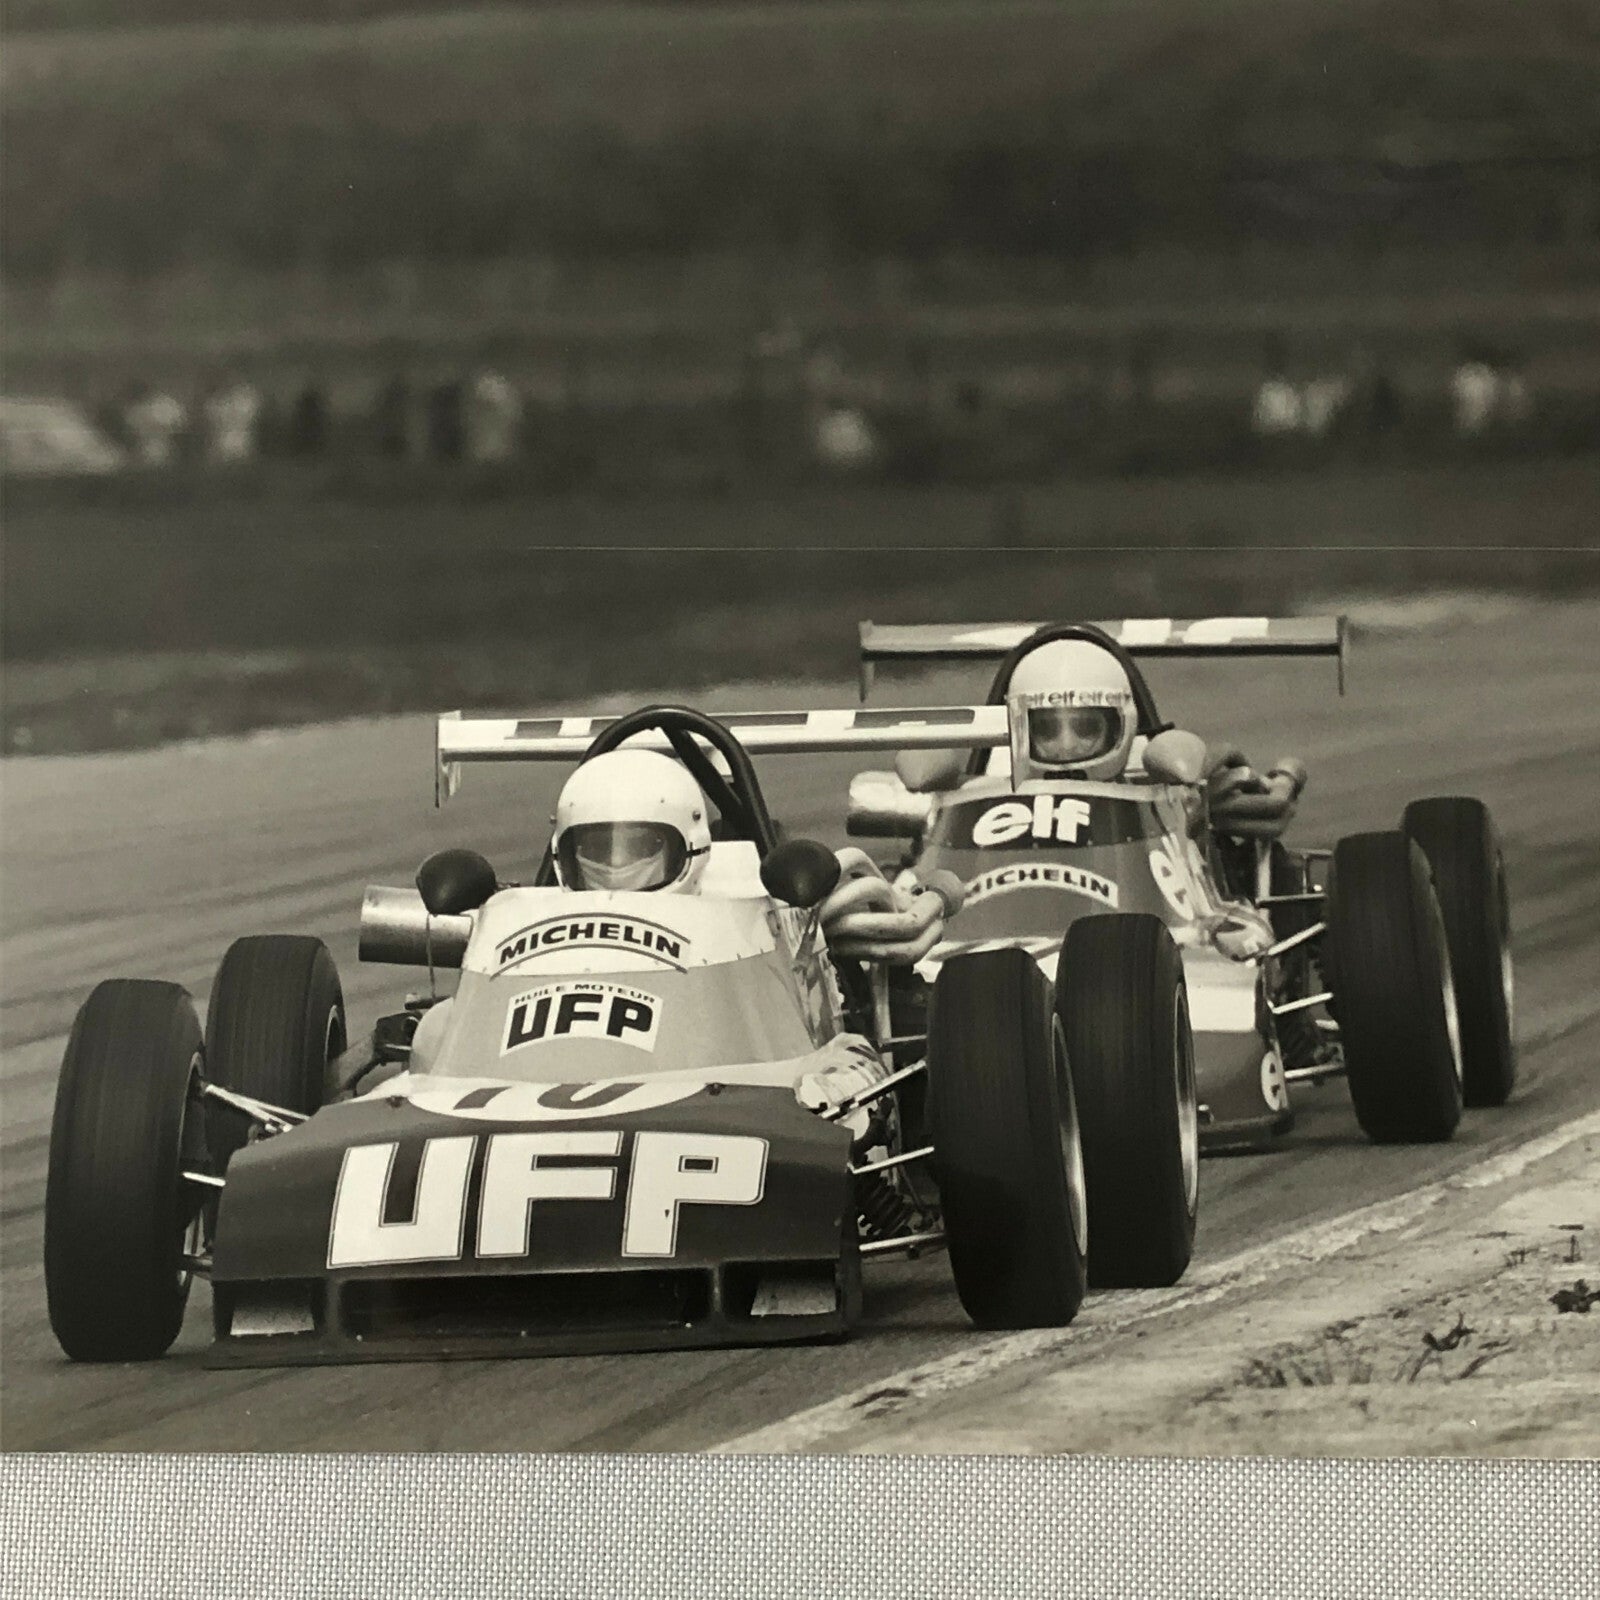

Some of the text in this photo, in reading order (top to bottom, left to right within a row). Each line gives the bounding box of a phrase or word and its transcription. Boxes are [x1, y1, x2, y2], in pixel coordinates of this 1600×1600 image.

[1048, 690, 1075, 706] elf
[972, 795, 1090, 847] elf
[500, 922, 681, 965] MICHELIN
[575, 983, 655, 1004] MOTEUR
[507, 993, 653, 1050] UFP
[327, 1131, 769, 1269] UFP
